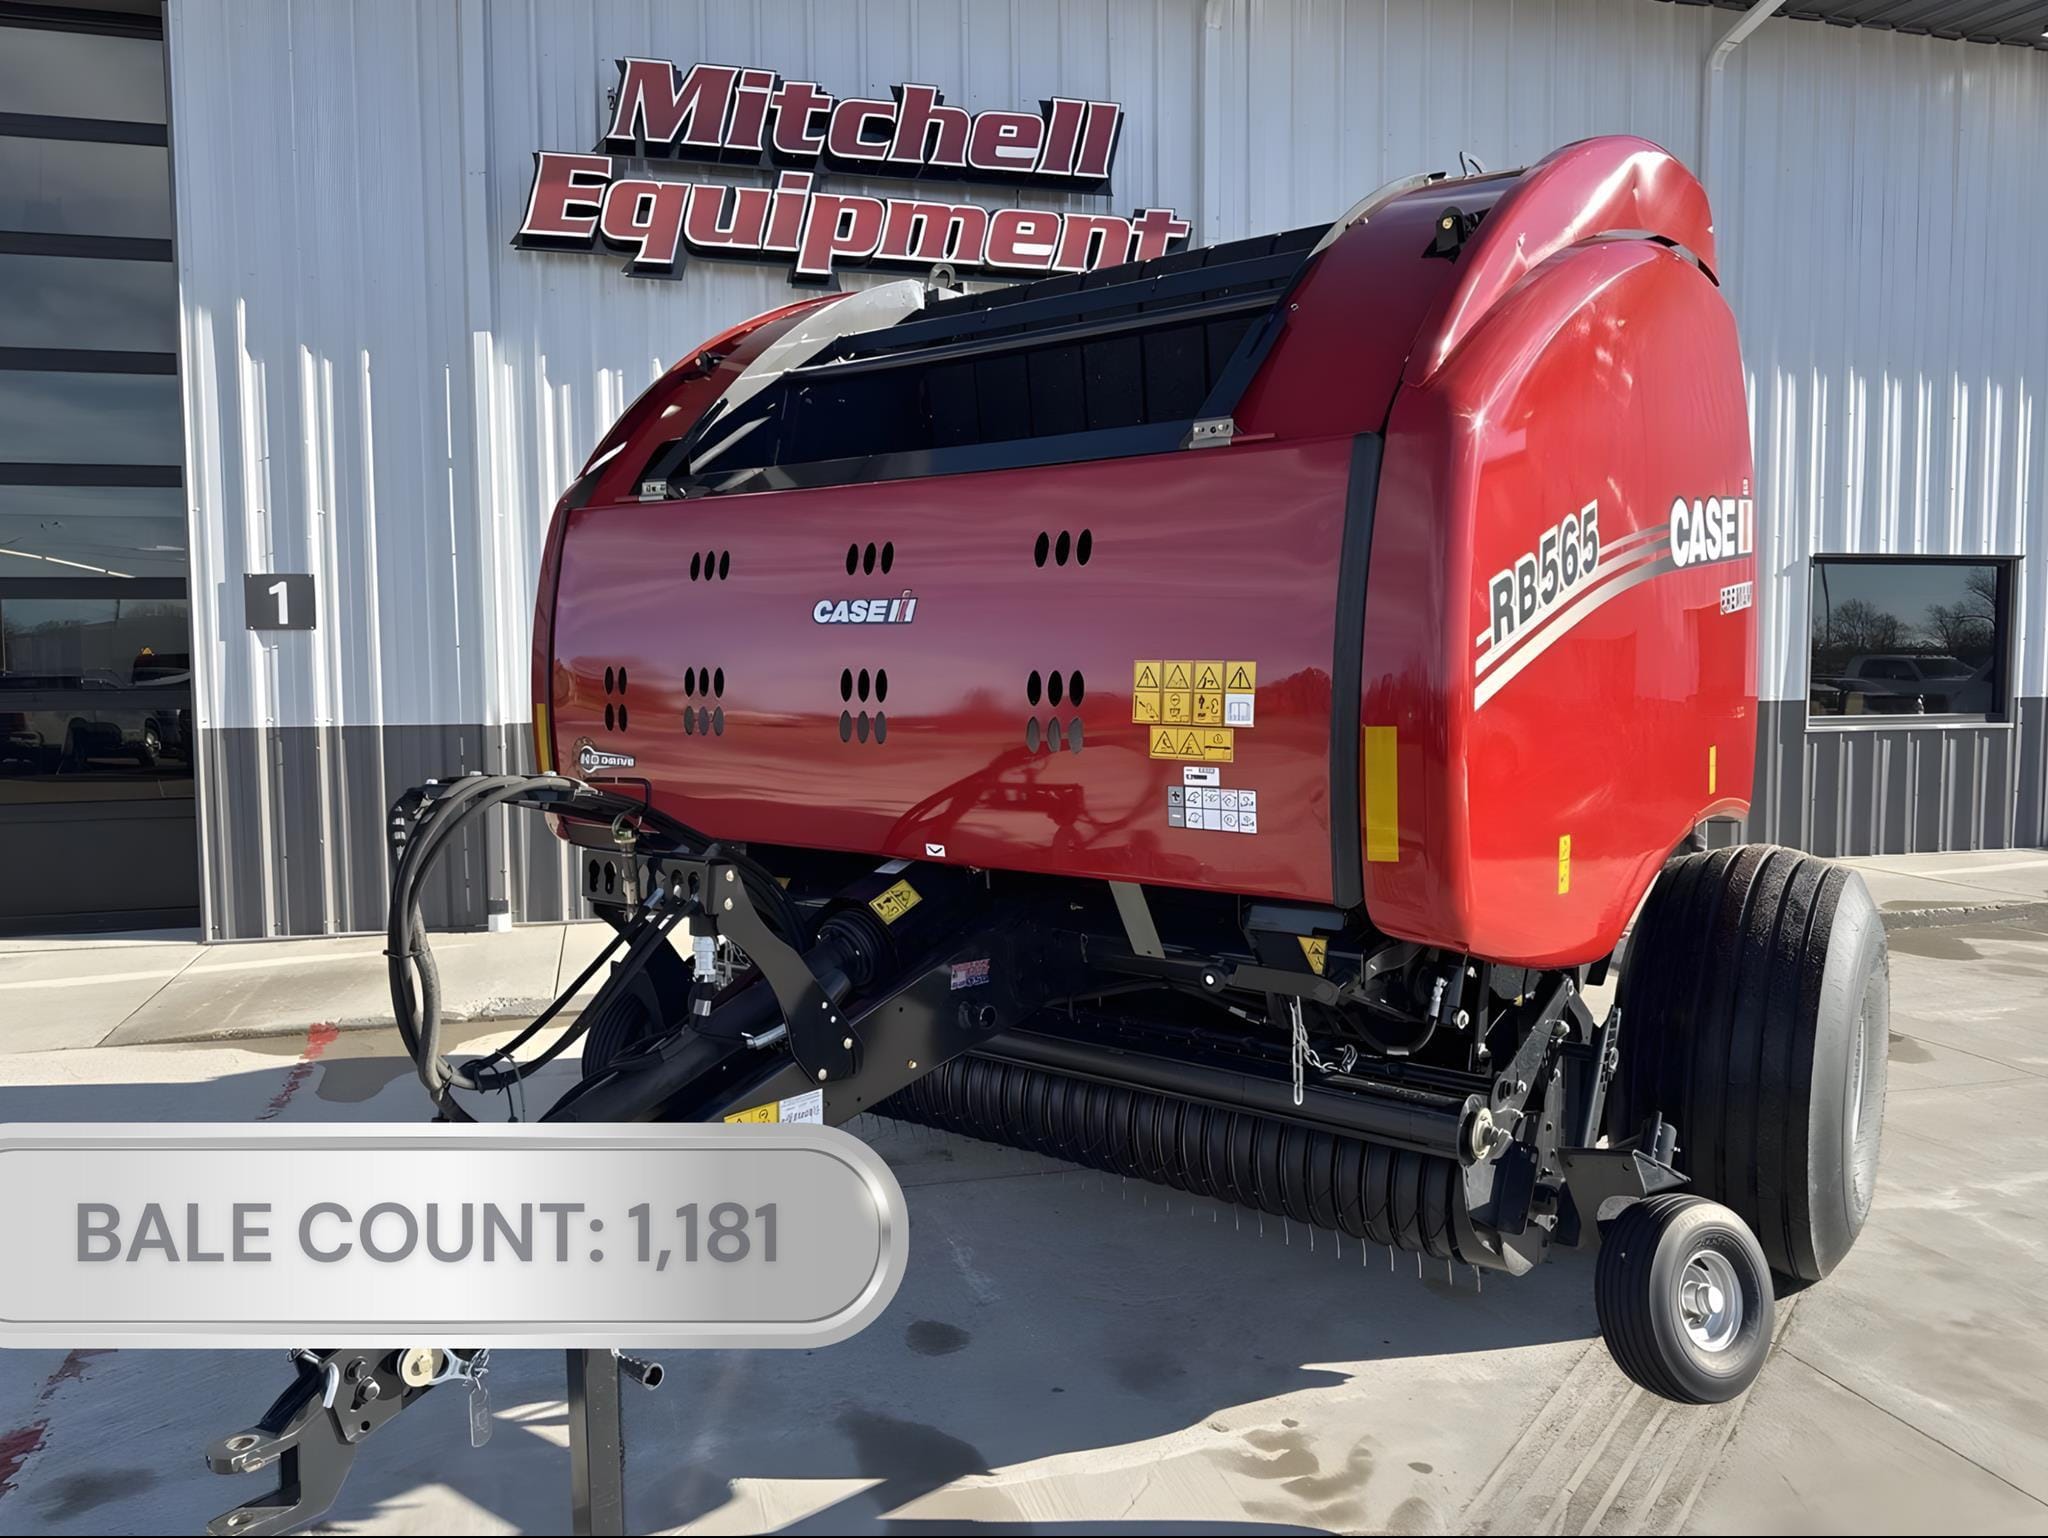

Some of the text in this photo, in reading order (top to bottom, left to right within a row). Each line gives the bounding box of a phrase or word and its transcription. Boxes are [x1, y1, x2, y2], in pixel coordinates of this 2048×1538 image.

[606, 56, 1122, 178] Mitchell
[519, 150, 1191, 275] Equipment
[1489, 499, 1600, 647] RB565
[1670, 497, 1735, 567] CASE
[268, 580, 289, 625] 1
[813, 600, 888, 623] CASE
